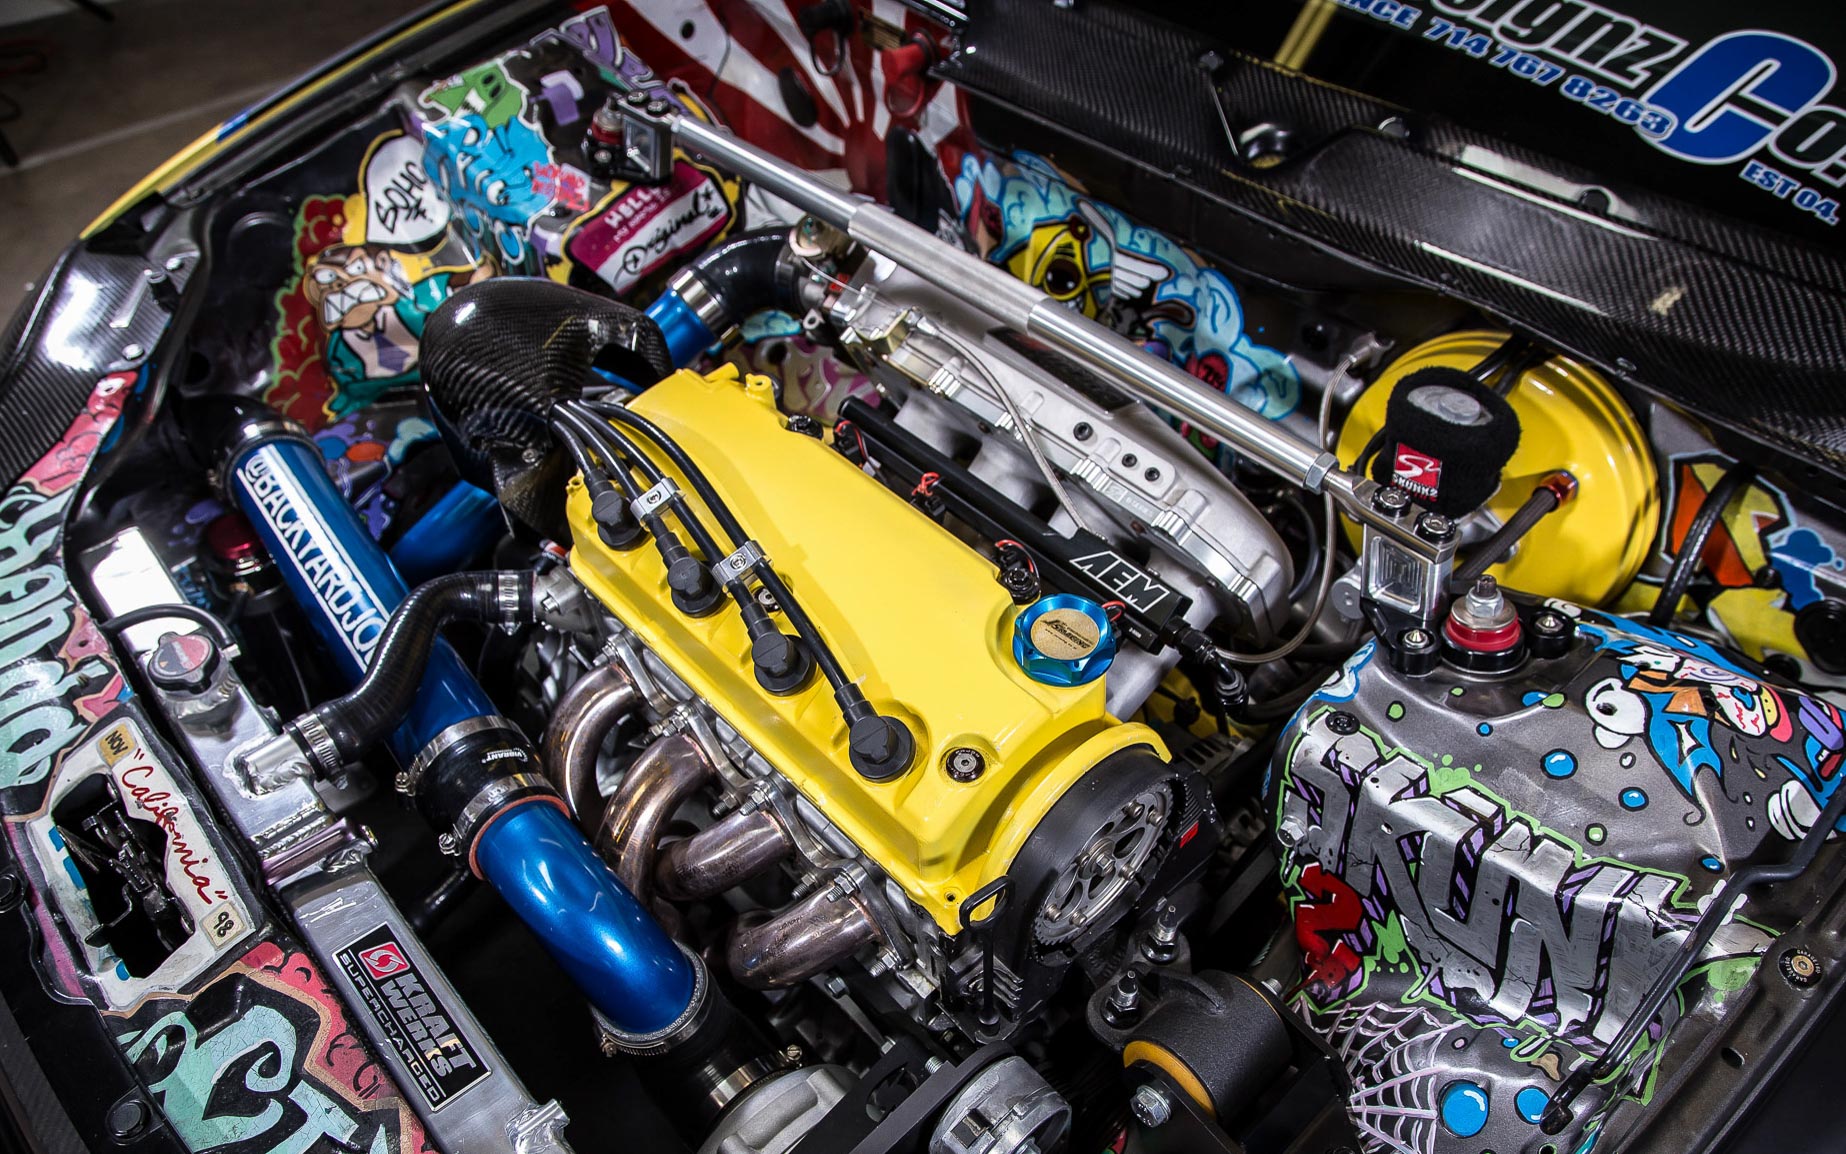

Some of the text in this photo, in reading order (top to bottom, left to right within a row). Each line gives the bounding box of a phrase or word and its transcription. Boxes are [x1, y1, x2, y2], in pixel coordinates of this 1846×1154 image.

[1423, 15, 1494, 58] 714
[1489, 44, 1566, 87] 767
[1559, 75, 1679, 142] 8263
[1739, 160, 1801, 199] EST
[1392, 472, 1438, 498] SKUNK2
[245, 453, 386, 666] @BACKYARDJO
[1069, 550, 1171, 614] AEM
[105, 730, 129, 756] NOV
[213, 910, 235, 938] 98
[339, 953, 440, 1102] SUPERCHARGED
[380, 979, 453, 1077] WERKS
[395, 972, 477, 1070] KRAFT
